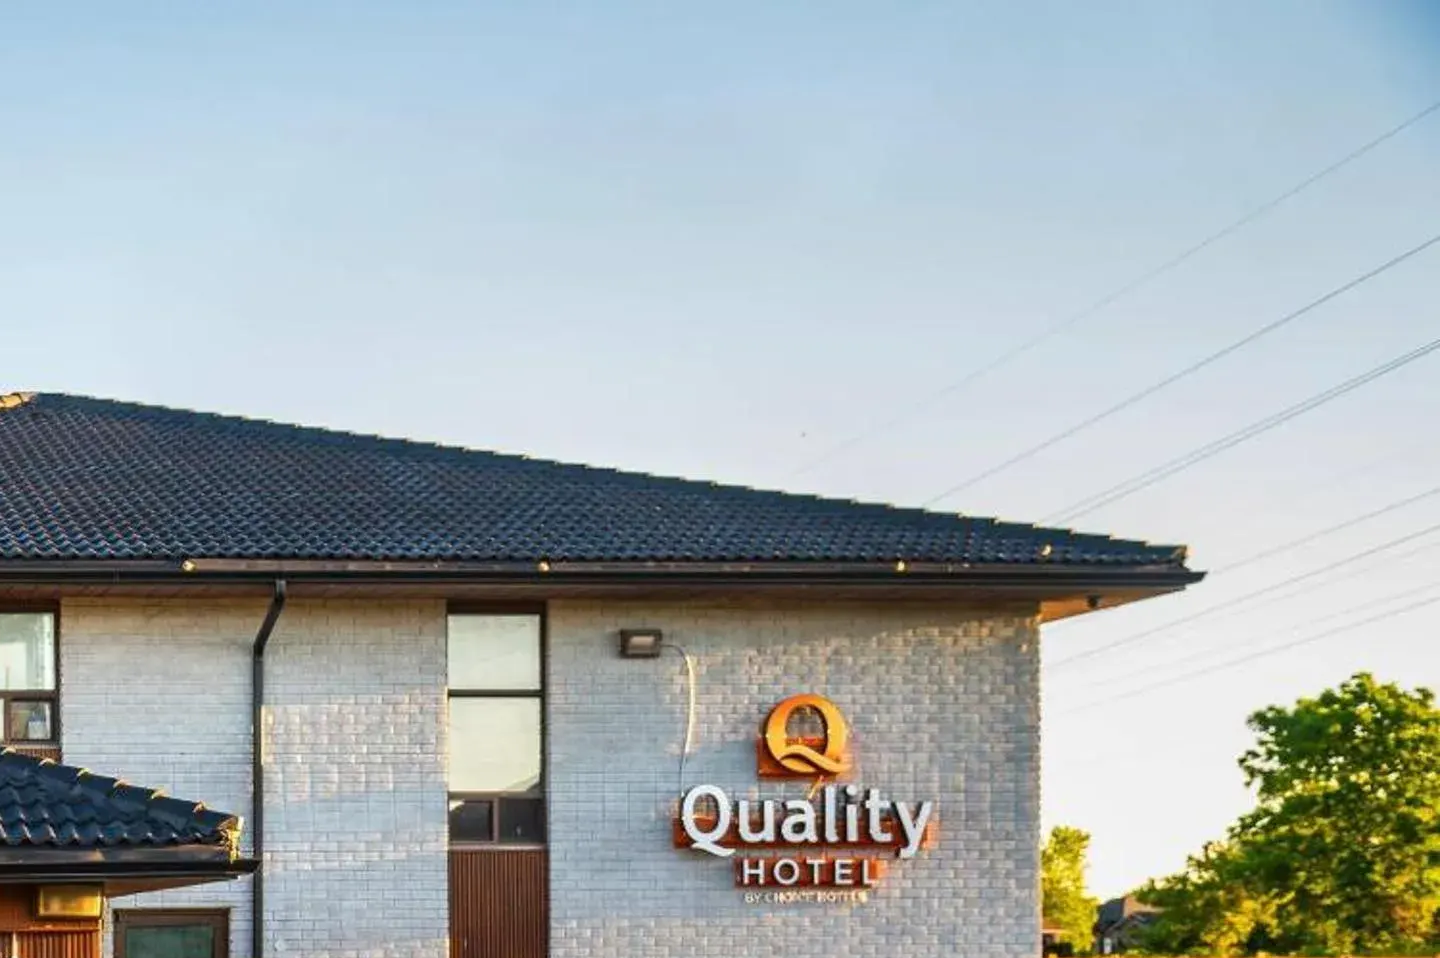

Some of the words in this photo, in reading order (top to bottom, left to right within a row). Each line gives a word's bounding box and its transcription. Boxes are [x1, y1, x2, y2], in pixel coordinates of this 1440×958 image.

[765, 694, 853, 773] Q
[681, 784, 933, 859] Quality
[742, 859, 877, 885] HOTEL
[744, 891, 760, 903] BY
